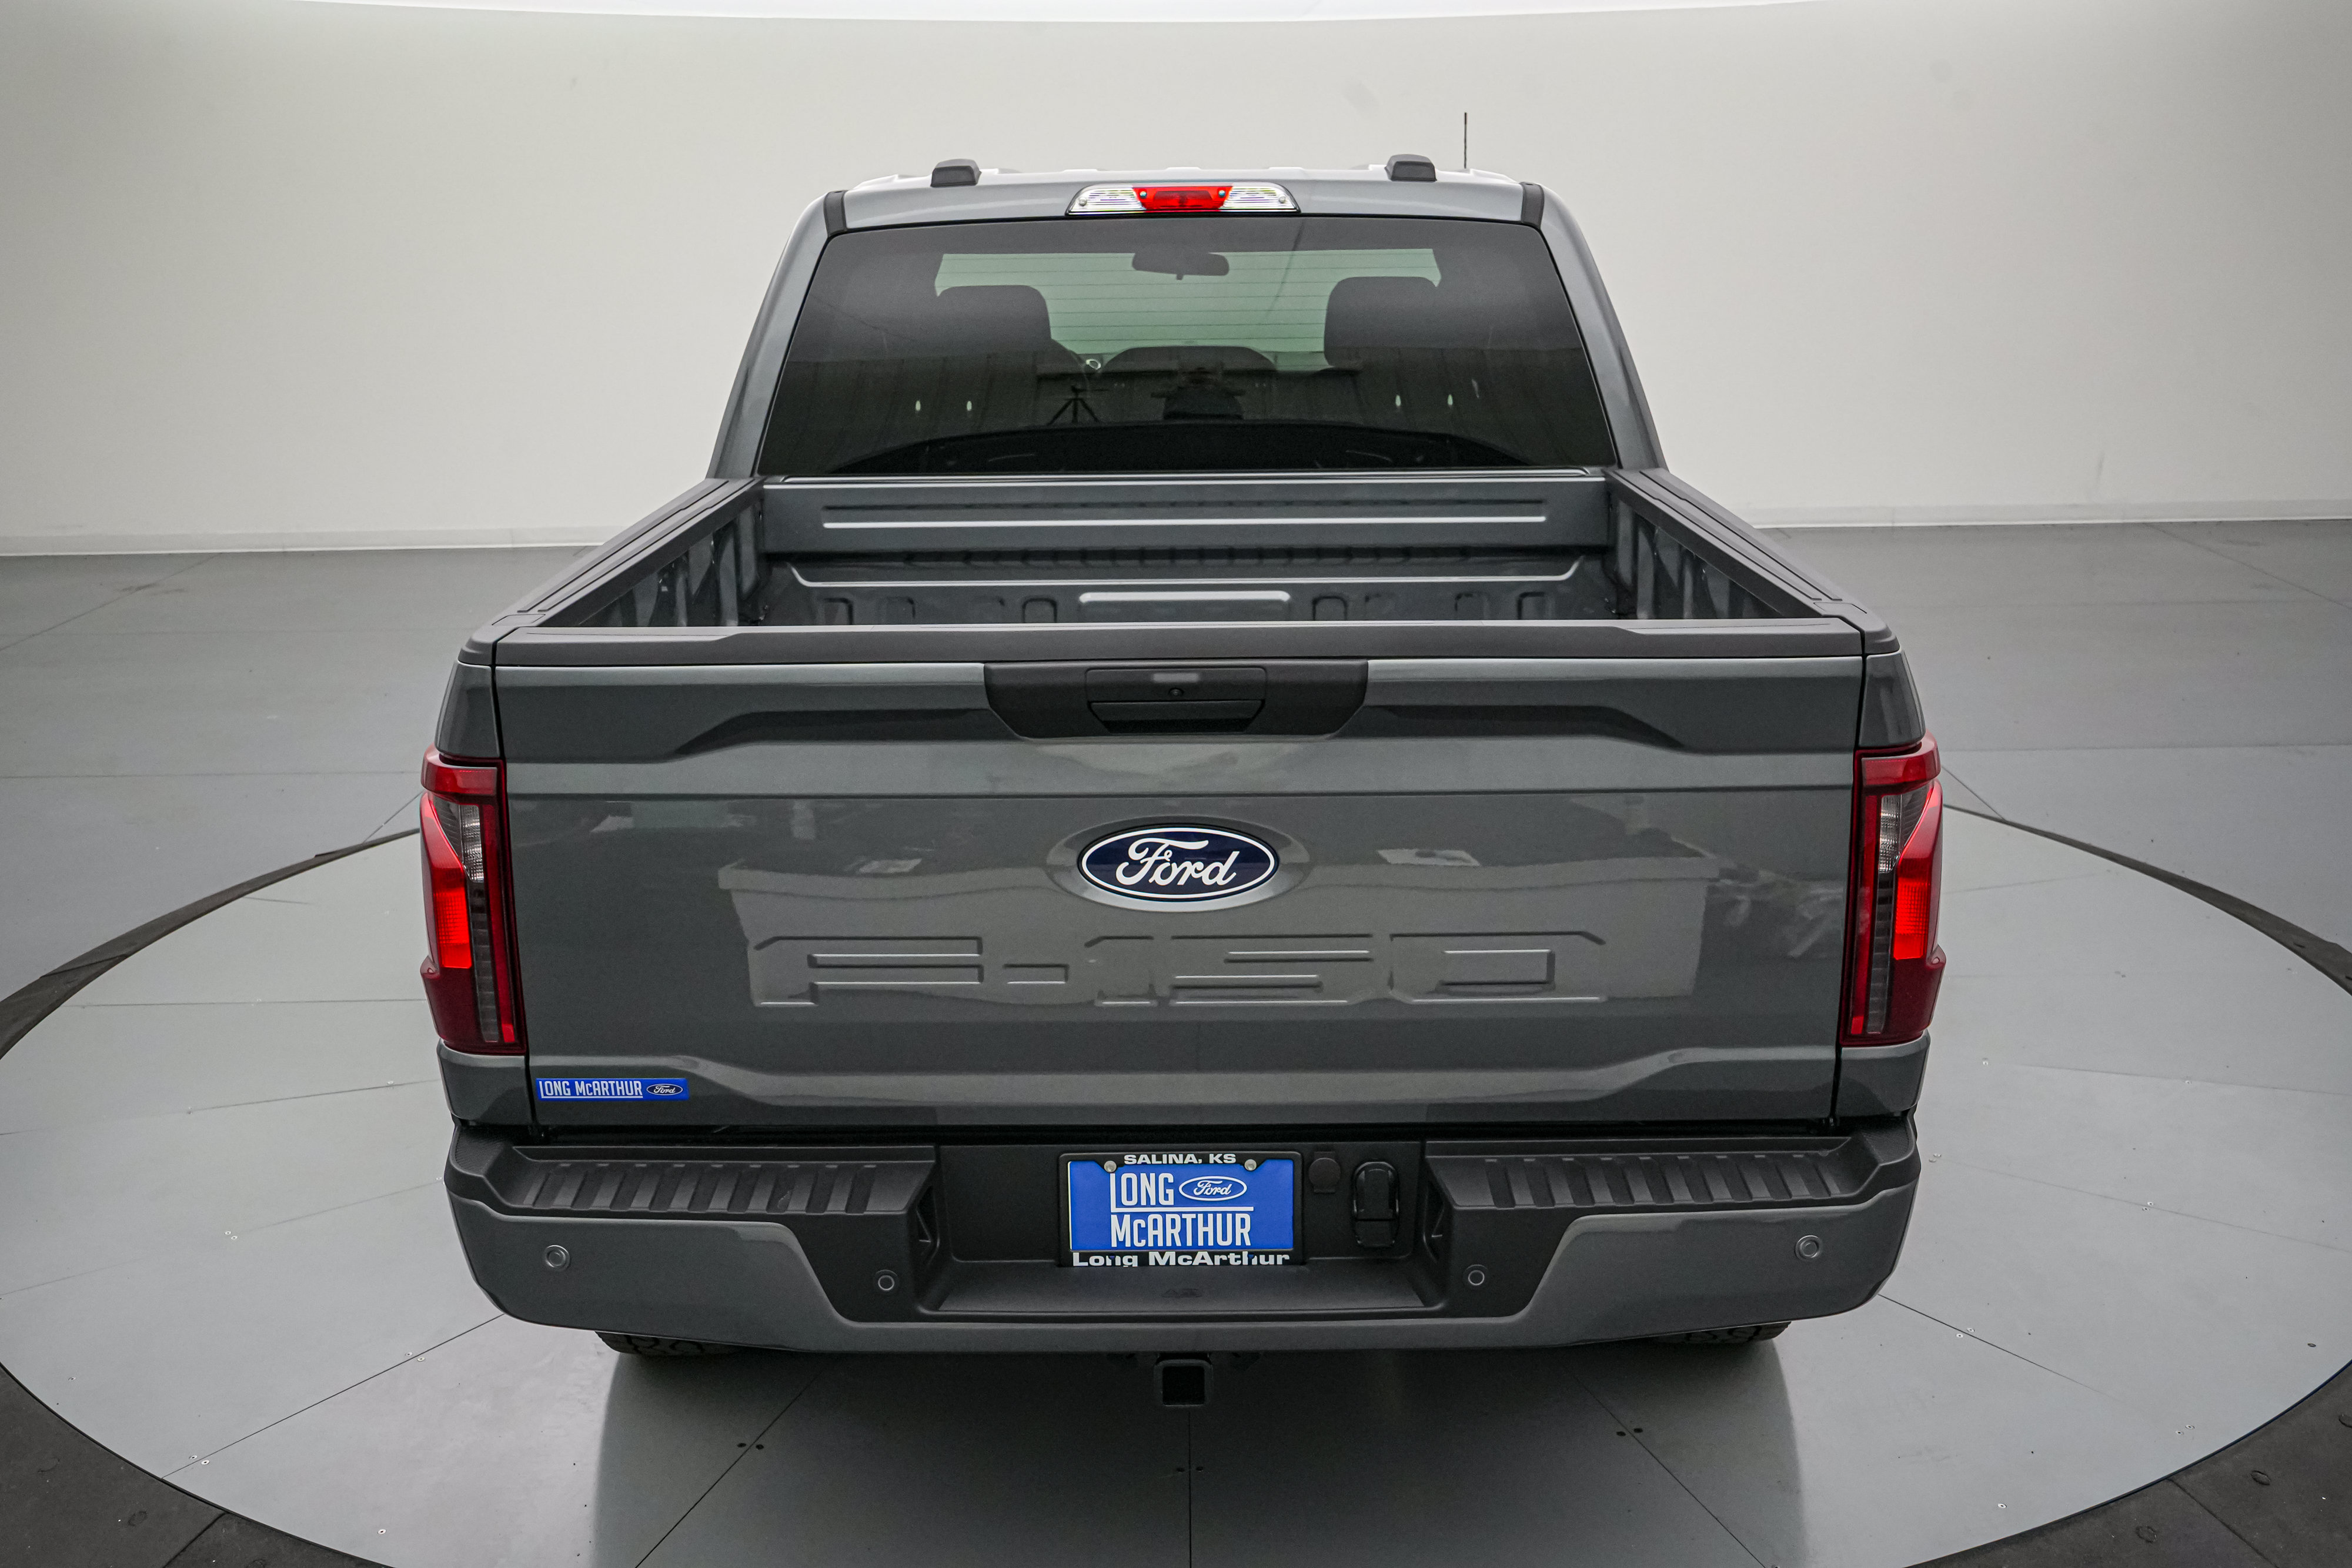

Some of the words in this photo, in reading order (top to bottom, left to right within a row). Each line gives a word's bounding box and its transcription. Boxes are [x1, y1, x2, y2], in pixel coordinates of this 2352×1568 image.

[1116, 838, 1240, 885] Ford
[539, 1081, 570, 1097] LONG
[574, 1081, 643, 1096] McARTHUR
[653, 1085, 676, 1094] Ford
[1124, 1154, 1203, 1165] SALINA,
[1209, 1153, 1236, 1164] KS
[1110, 1172, 1174, 1209] LONG
[1193, 1180, 1232, 1196] Ford
[1111, 1213, 1251, 1248] McARTHUR
[1073, 1252, 1138, 1267] Long
[1148, 1251, 1290, 1266] McArthur
